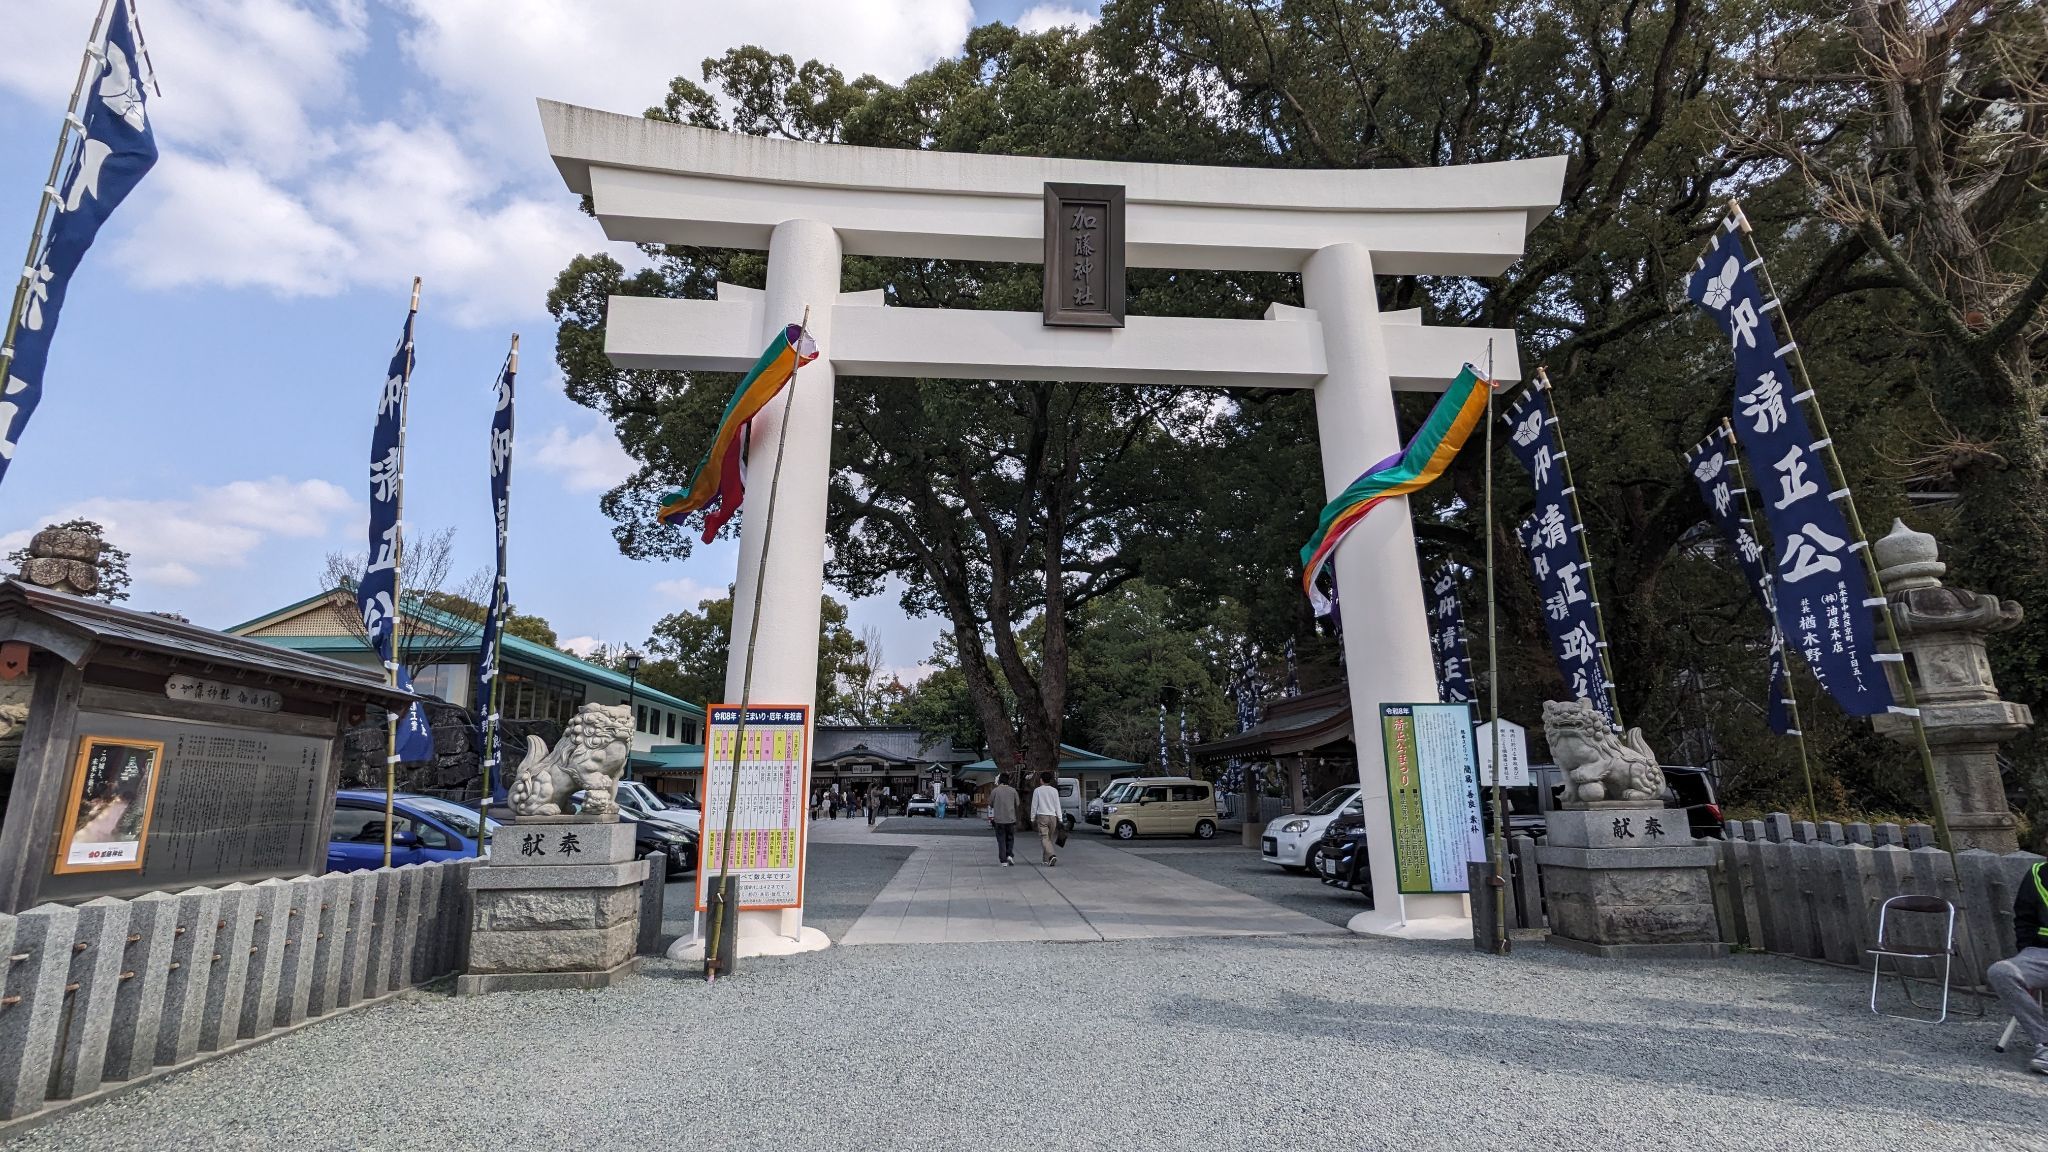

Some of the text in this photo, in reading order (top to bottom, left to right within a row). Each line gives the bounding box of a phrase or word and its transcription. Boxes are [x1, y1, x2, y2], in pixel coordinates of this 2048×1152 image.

[1070, 206, 1097, 306] 加藤神社
[714, 711, 803, 721] 令和8年・三まいり・厄年・年祝表
[1385, 707, 1410, 715] 令和8年
